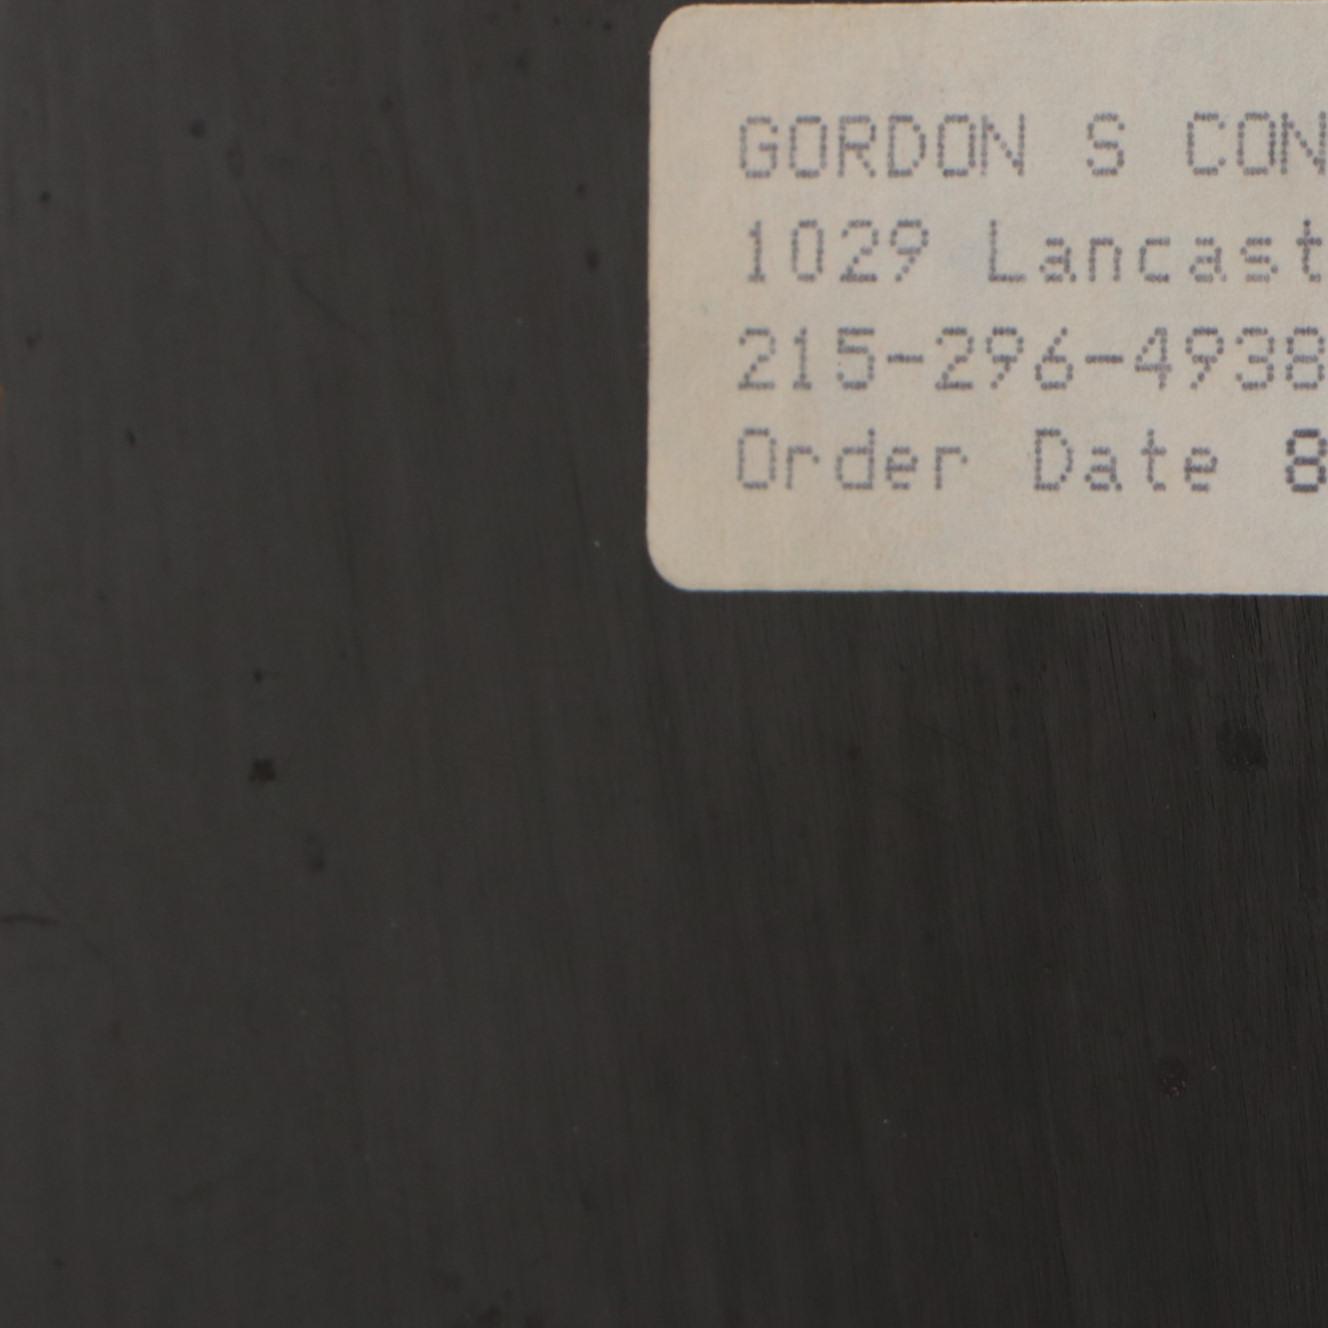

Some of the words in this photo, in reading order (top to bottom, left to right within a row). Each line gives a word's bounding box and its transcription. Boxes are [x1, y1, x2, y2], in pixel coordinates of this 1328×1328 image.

[740, 114, 1025, 179] GORDON
[1086, 113, 1125, 176] S
[748, 219, 929, 283] 1029
[738, 326, 1325, 391] 215-296-4938
[737, 428, 968, 490] Order
[1034, 428, 1218, 492] Date
